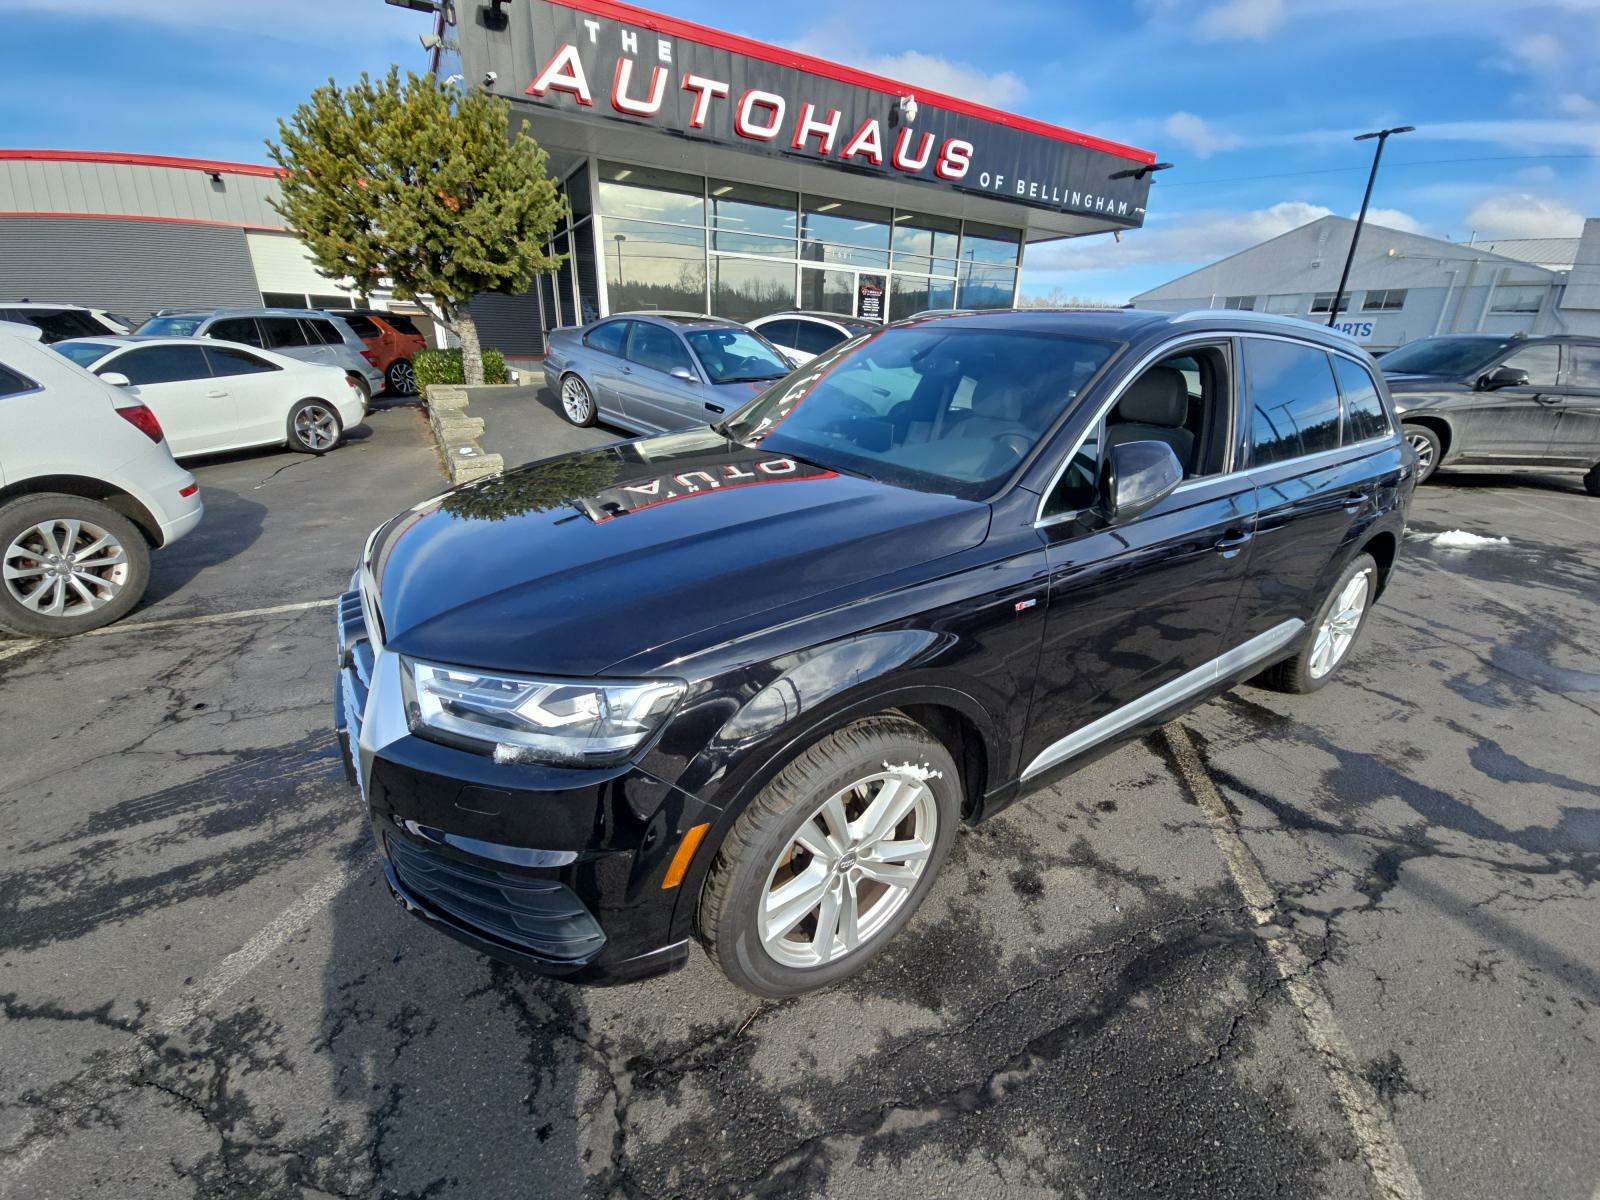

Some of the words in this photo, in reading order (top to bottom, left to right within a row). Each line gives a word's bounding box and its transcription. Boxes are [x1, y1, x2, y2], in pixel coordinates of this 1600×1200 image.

[584, 19, 672, 63] THE
[525, 42, 974, 180] AUTOHAUS
[979, 172, 1004, 191] OF
[1016, 179, 1128, 216] BELLINGHAM
[1325, 322, 1373, 337] ARTS
